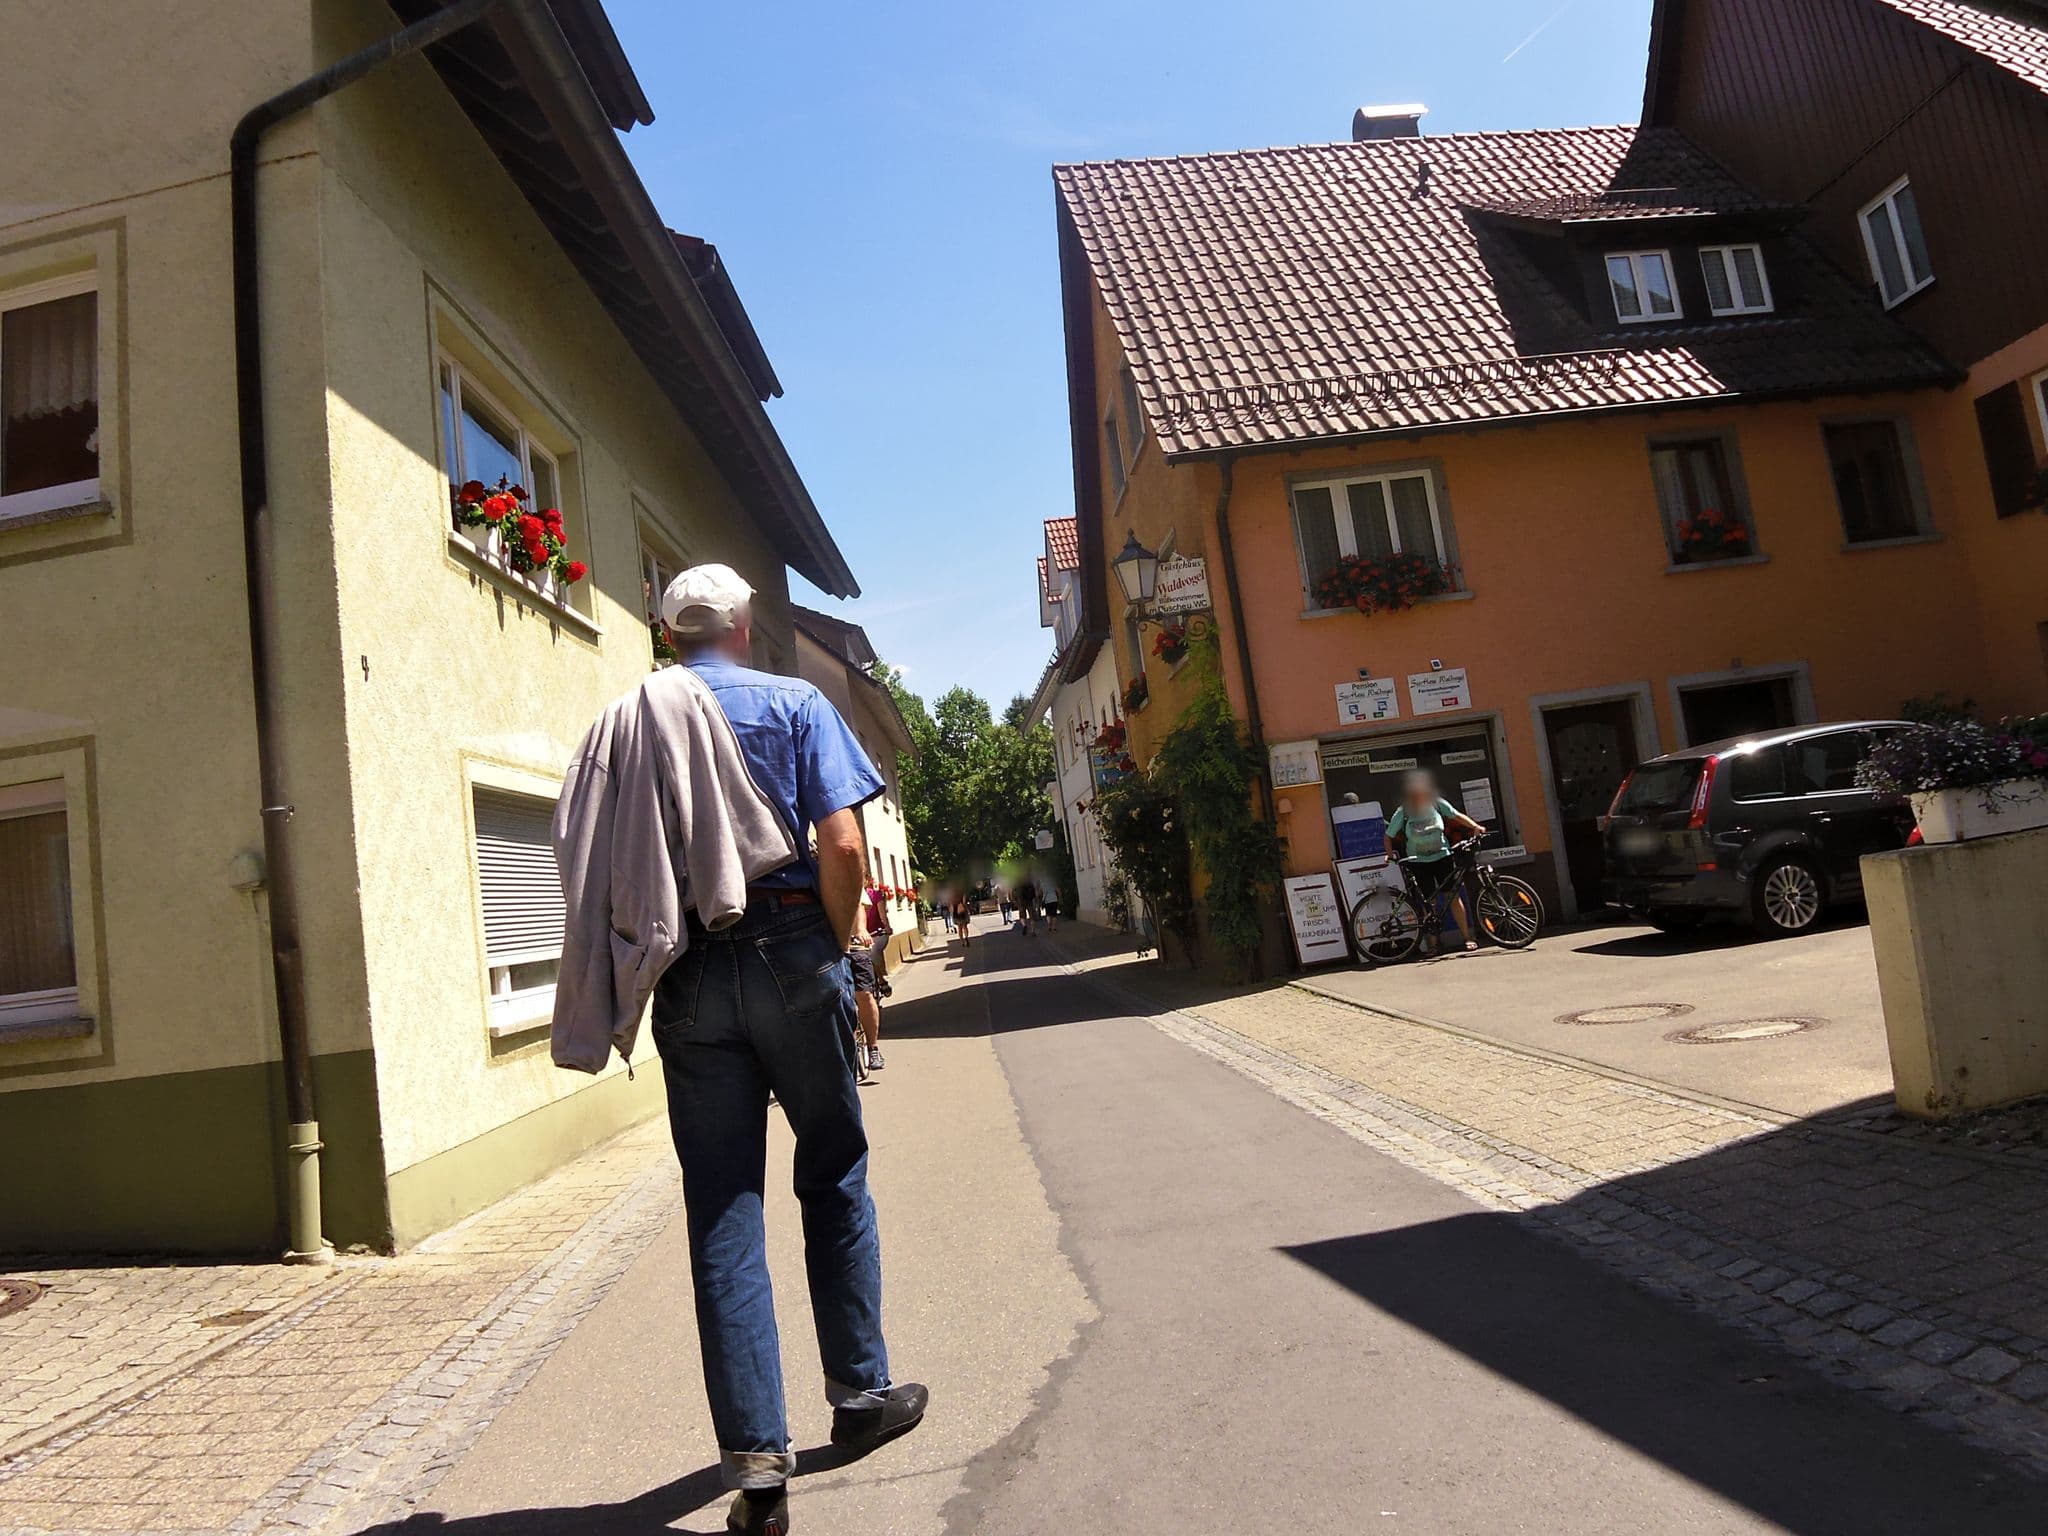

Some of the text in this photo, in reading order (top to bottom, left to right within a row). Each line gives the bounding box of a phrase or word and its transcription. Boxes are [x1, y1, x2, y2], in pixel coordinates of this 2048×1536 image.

[1157, 569, 1204, 596] Waldvogel
[1193, 600, 1208, 608] WC
[1352, 682, 1378, 690] Pension
[1360, 871, 1383, 880] HEUTE
[1299, 894, 1322, 902] HEUTE
